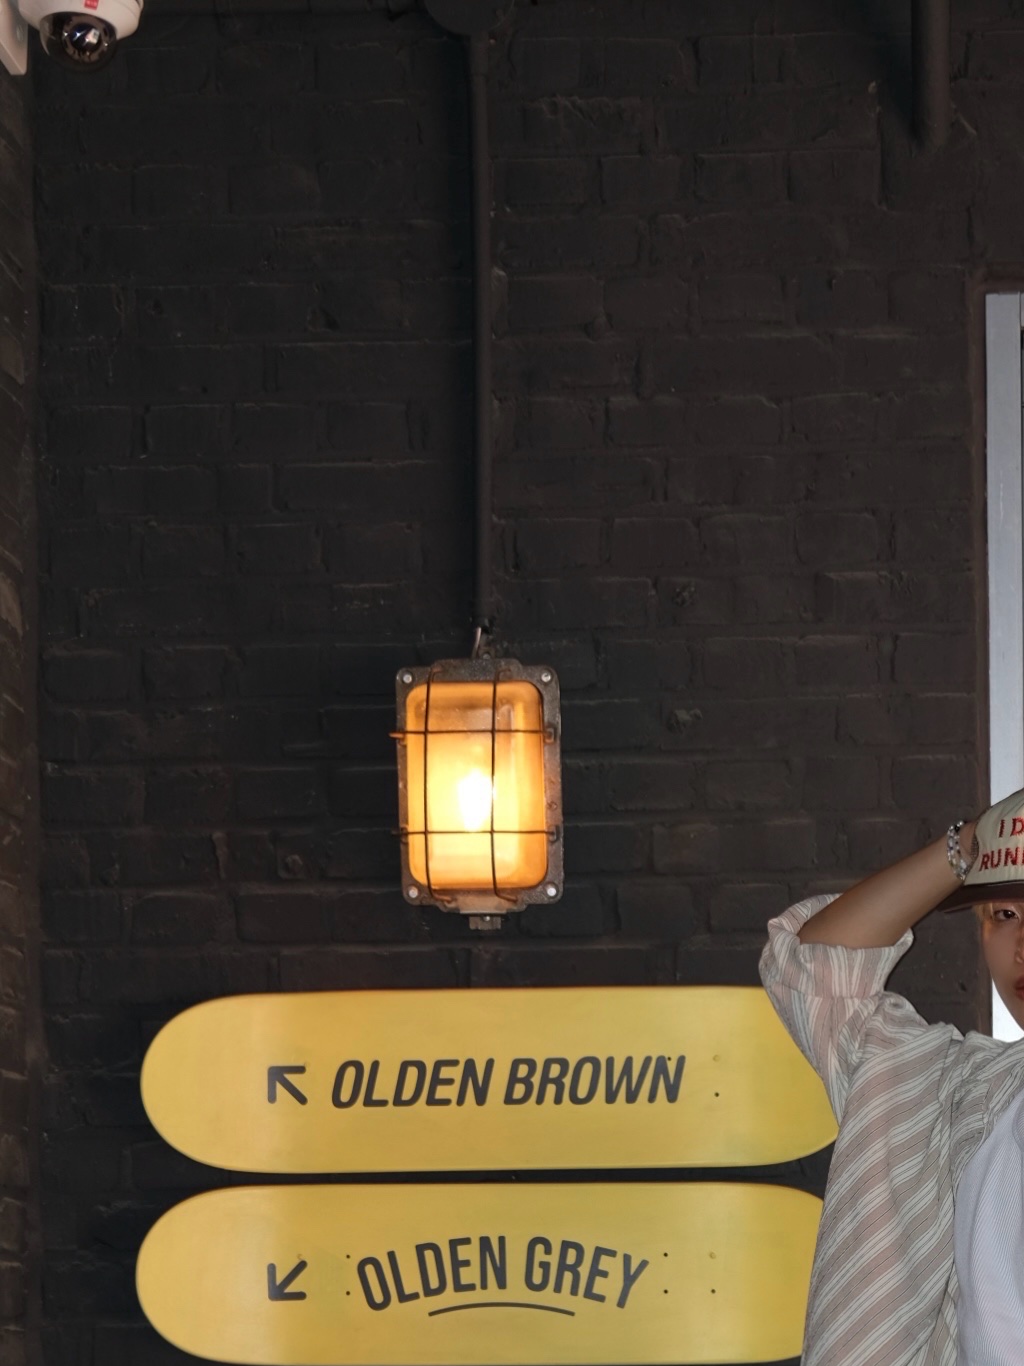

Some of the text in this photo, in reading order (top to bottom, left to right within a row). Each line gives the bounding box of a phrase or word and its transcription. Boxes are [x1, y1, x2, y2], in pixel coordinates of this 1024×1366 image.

[998, 818, 1006, 838] I
[332, 1054, 687, 1108] OLDEN BROWN
[356, 1236, 650, 1311] OLDEN GREY
